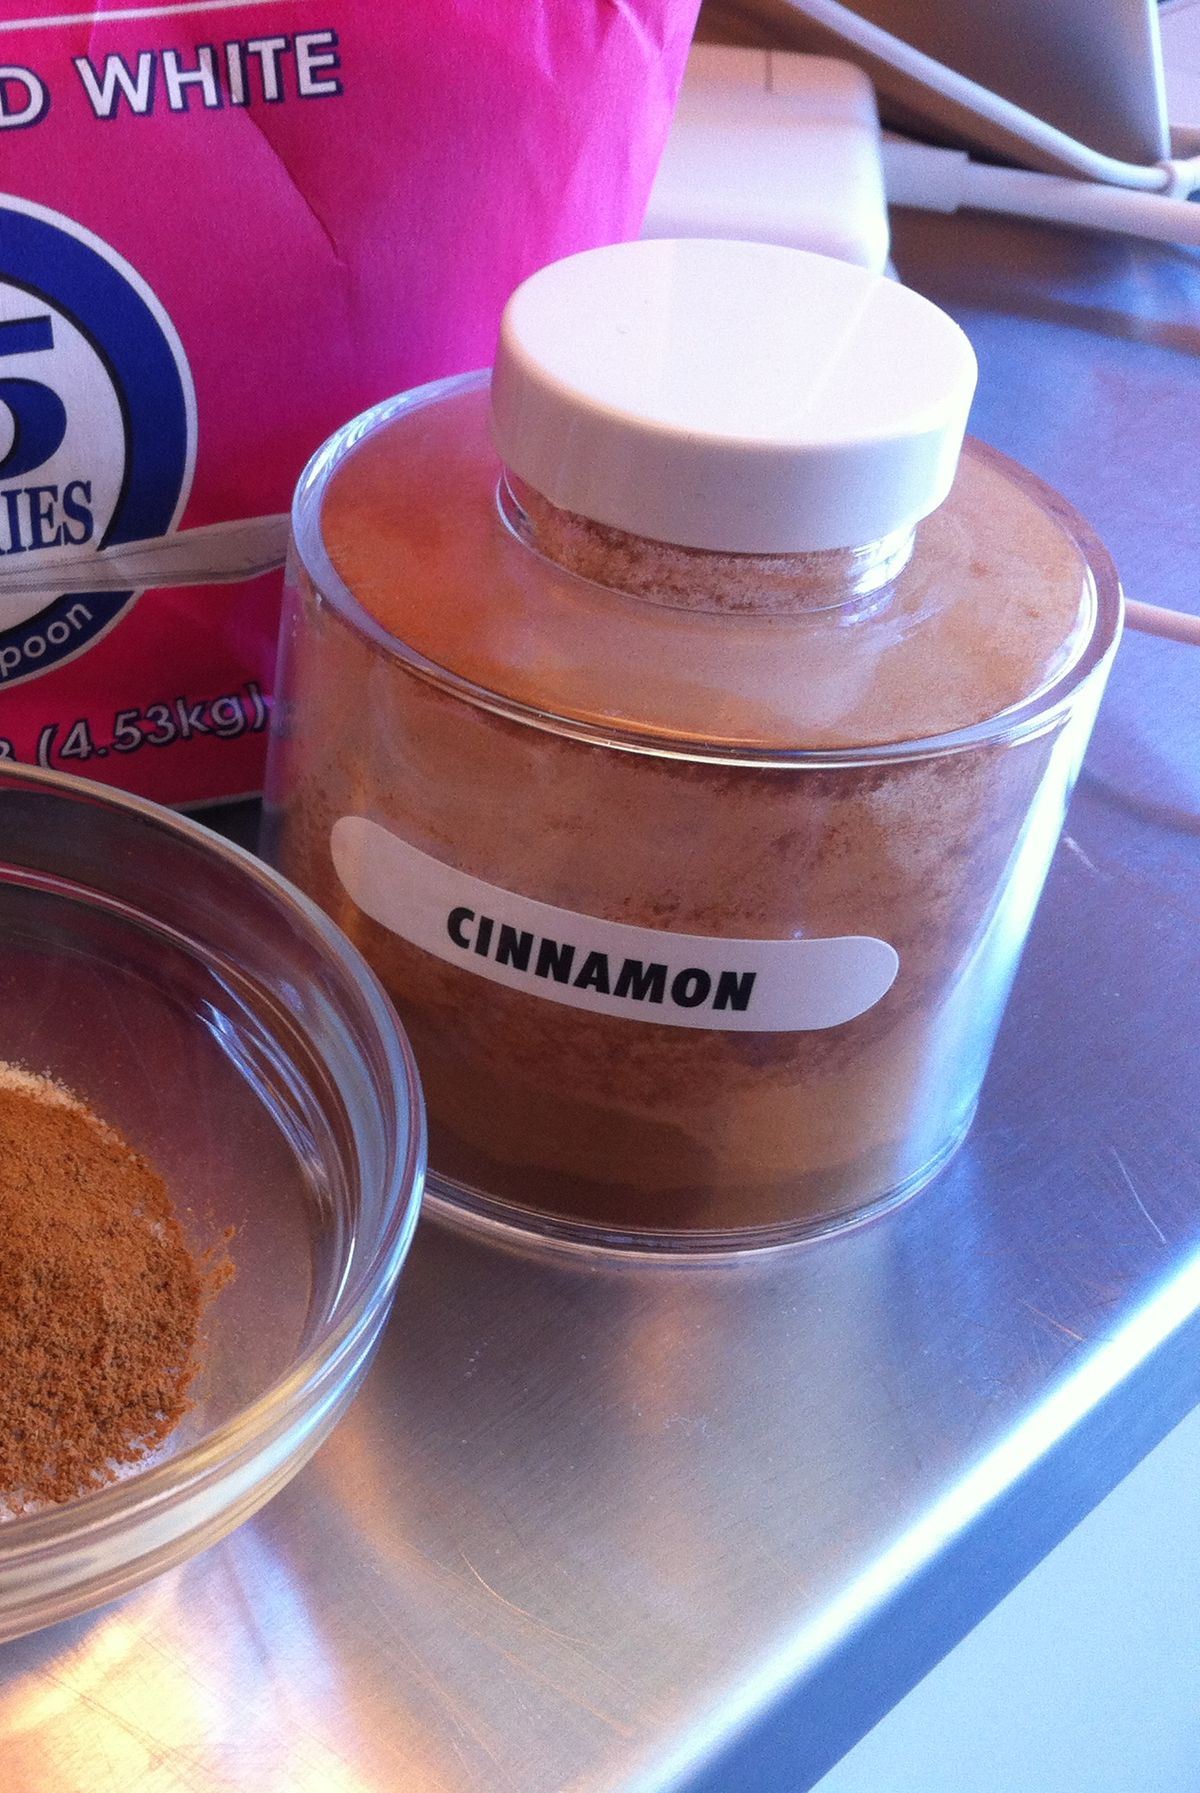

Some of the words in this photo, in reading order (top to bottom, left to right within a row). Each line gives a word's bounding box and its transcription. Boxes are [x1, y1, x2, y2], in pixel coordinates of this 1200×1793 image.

[74, 29, 341, 119] WHITE
[38, 682, 268, 770] (4.53kg)
[447, 906, 757, 1011] CINNAMON
